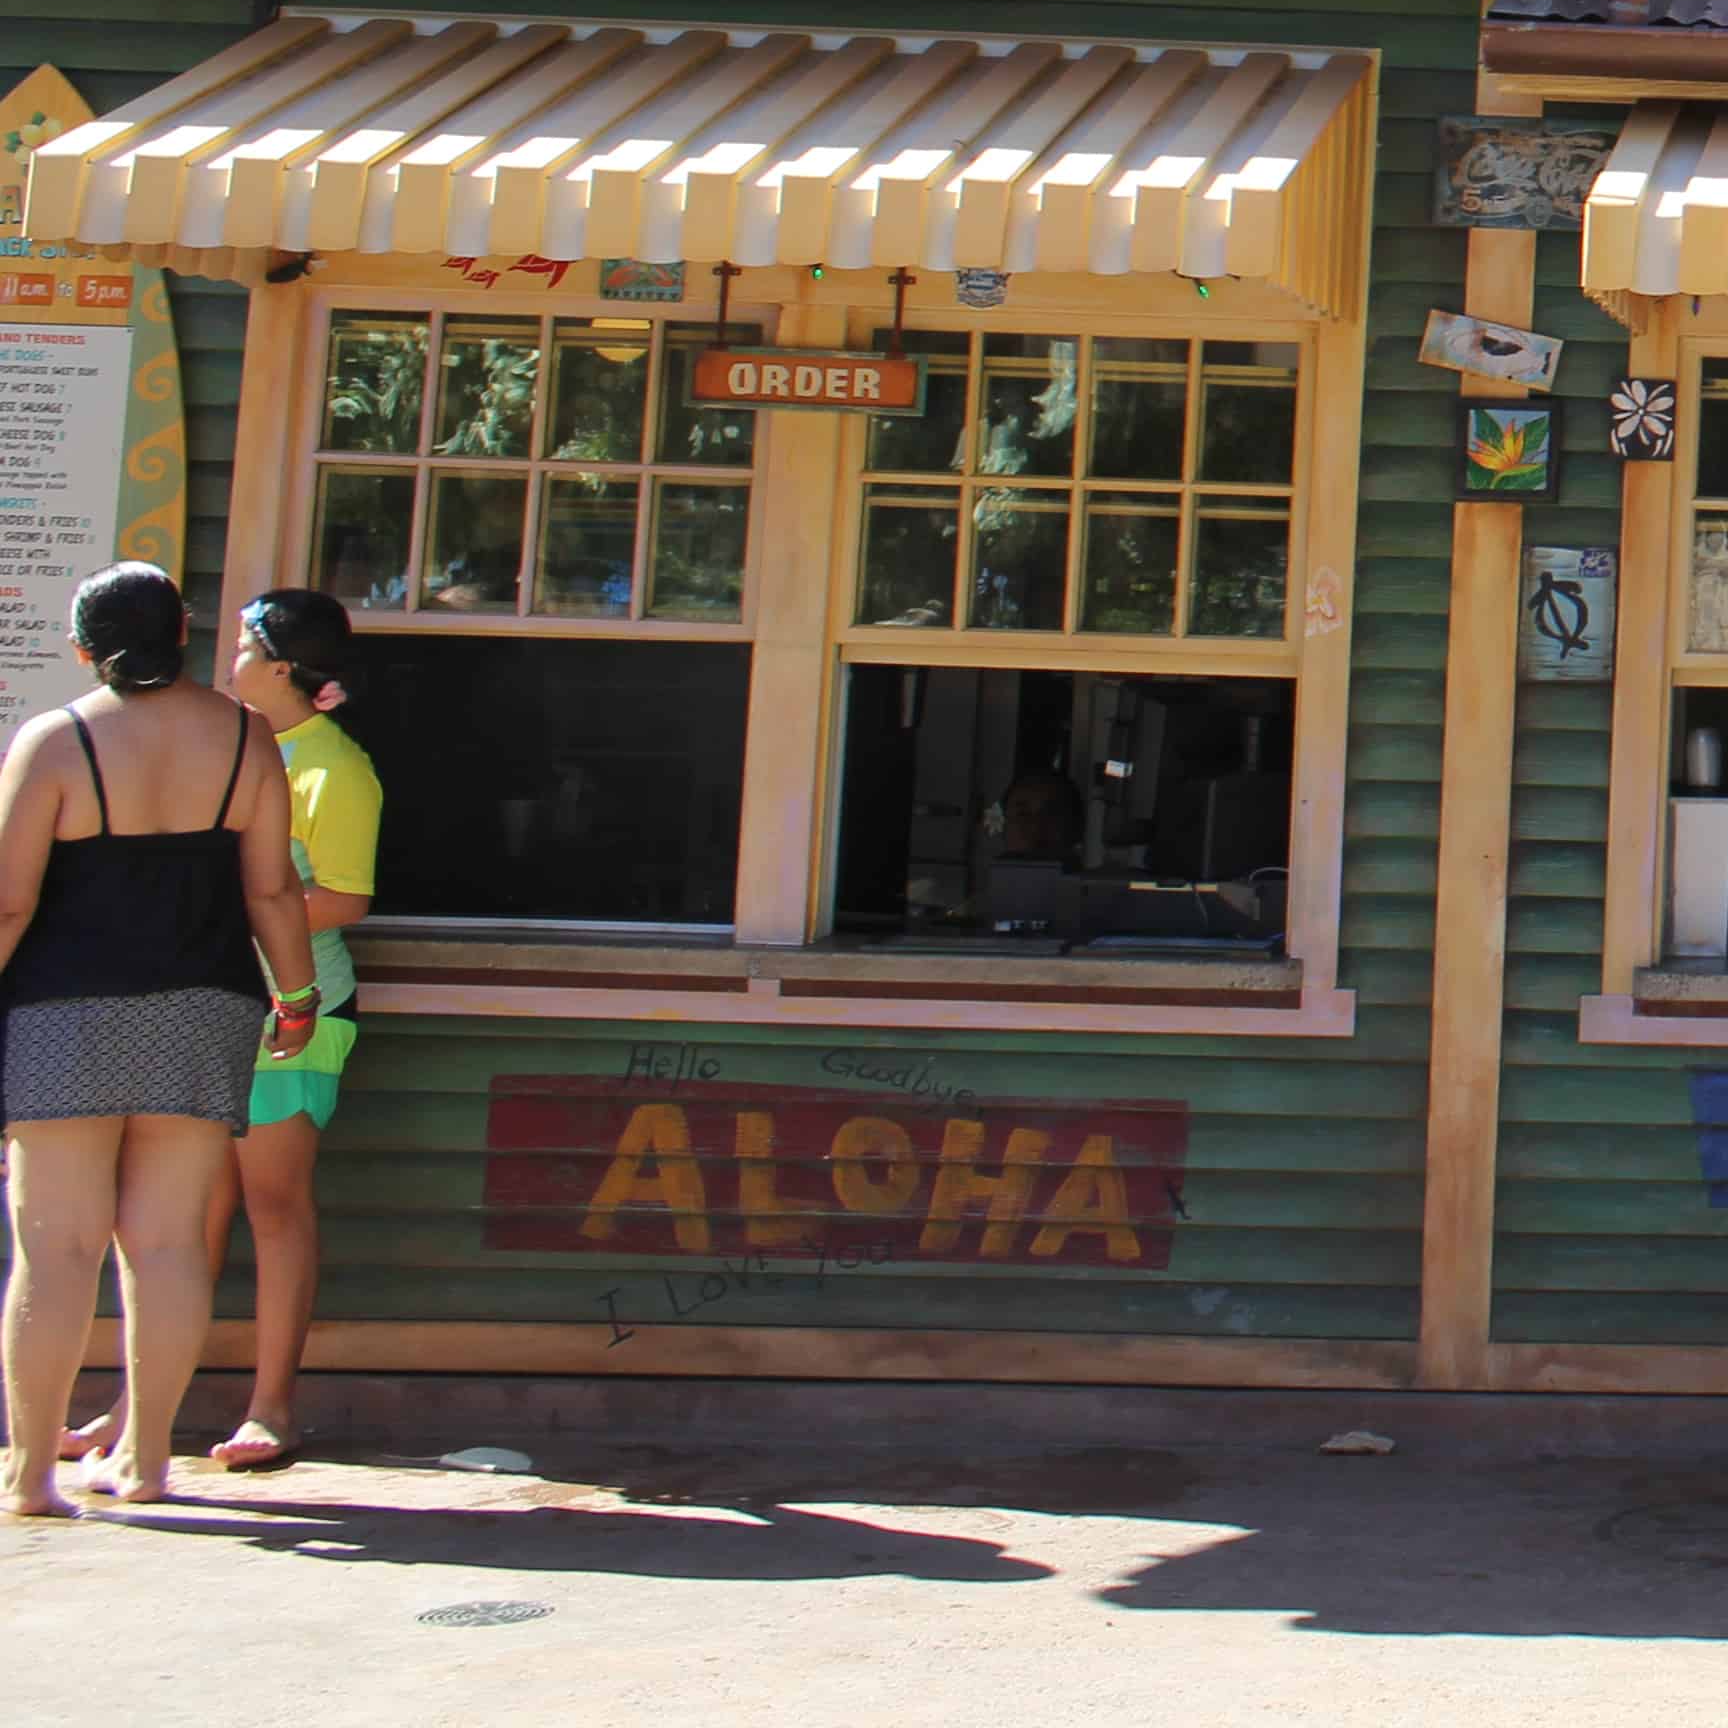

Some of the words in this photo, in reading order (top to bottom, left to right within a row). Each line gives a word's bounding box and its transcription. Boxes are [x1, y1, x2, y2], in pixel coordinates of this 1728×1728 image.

[727, 362, 881, 400] ORDER
[623, 1040, 721, 1092] Hello
[577, 1101, 1143, 1264] ALOHA
